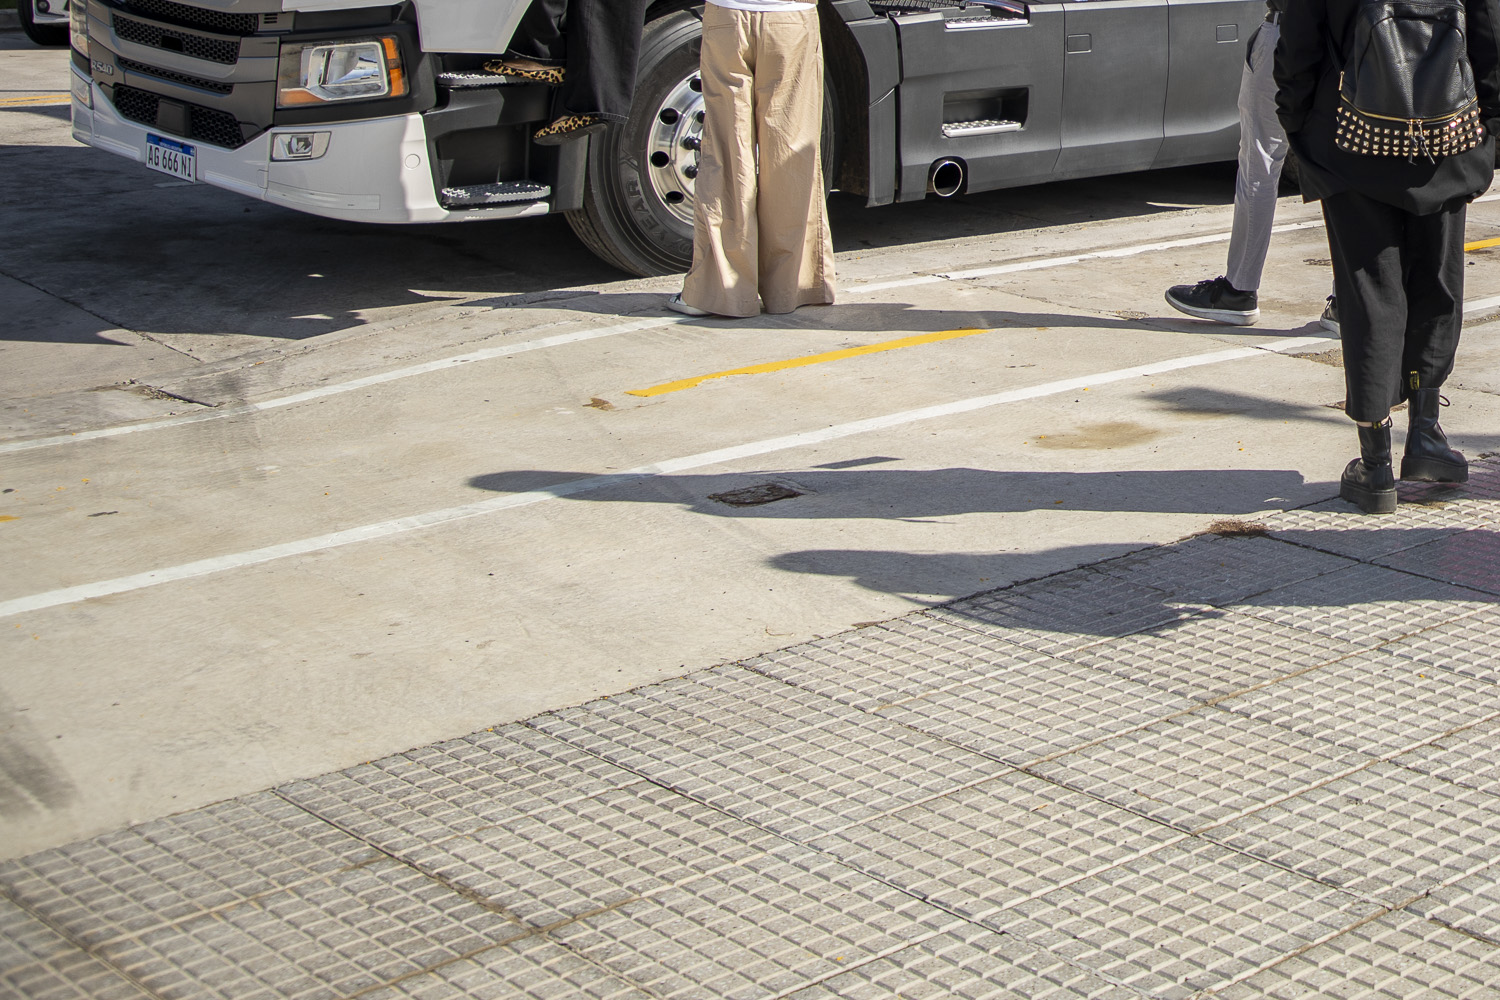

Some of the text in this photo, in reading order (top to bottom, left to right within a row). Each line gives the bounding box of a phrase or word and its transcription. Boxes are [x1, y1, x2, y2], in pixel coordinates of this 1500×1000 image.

[147, 145, 160, 167] AG
[162, 150, 179, 173] 666
[181, 155, 192, 178] NI
